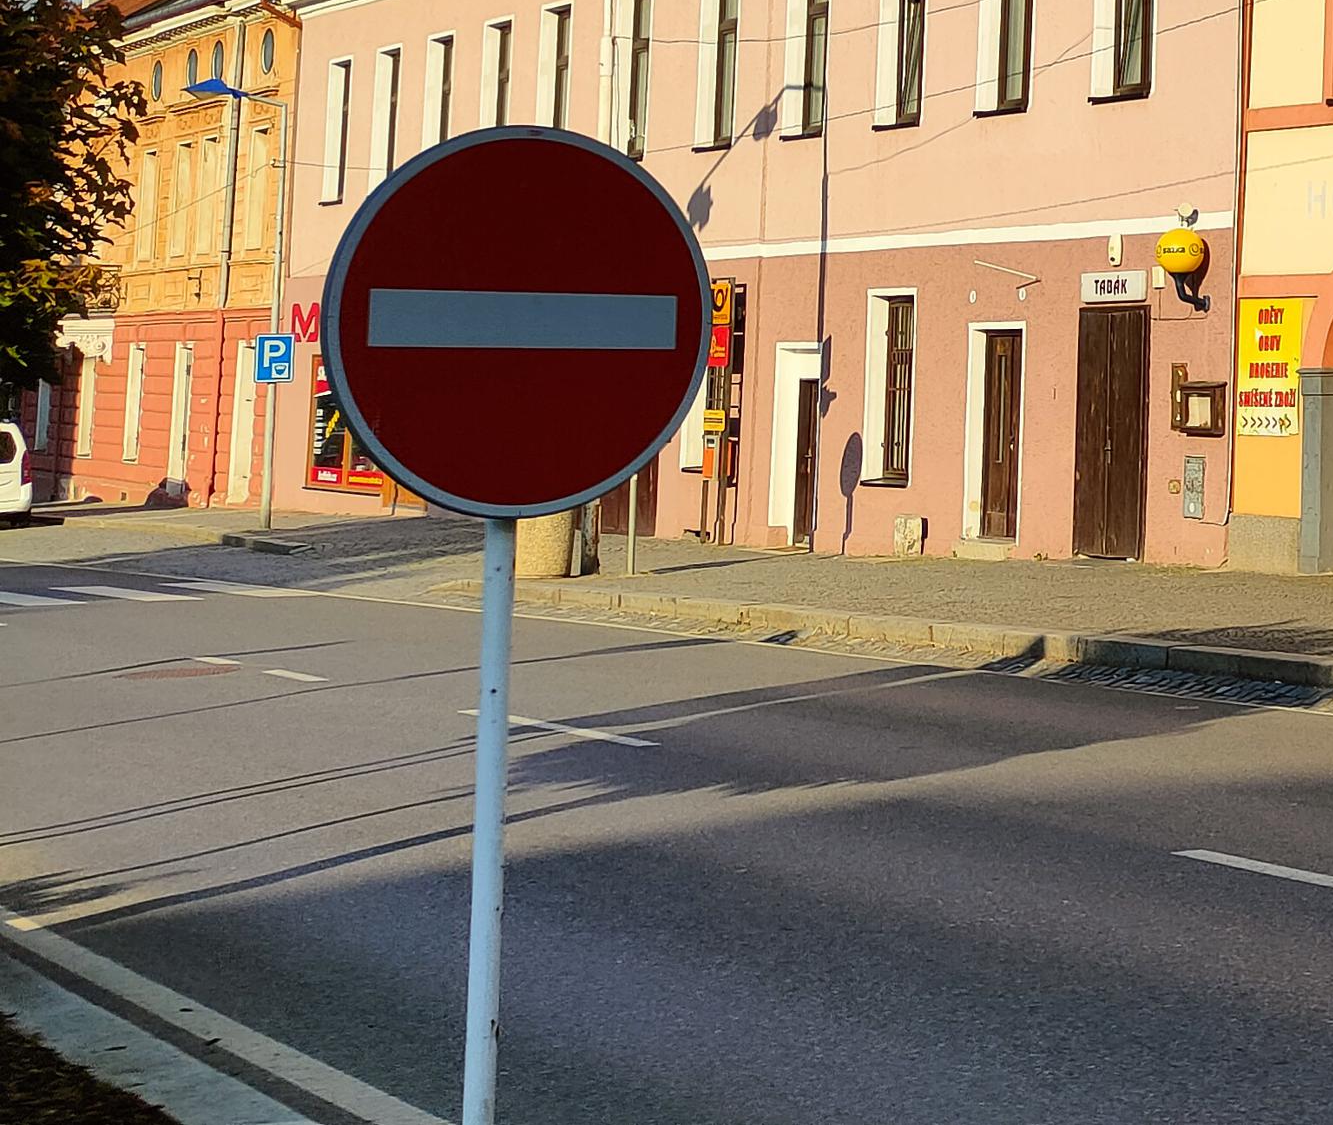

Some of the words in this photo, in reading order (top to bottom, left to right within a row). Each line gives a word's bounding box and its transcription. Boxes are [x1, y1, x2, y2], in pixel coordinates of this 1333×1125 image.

[1094, 275, 1128, 296] TABÁK
[1258, 305, 1285, 325] ODĚVY
[1258, 335, 1281, 352] OBUV
[263, 340, 286, 368] P
[1249, 362, 1289, 379] DROGERIE
[1239, 388, 1273, 408] SMÍŠENÉ
[1274, 388, 1297, 408] ZBOŽÍ
